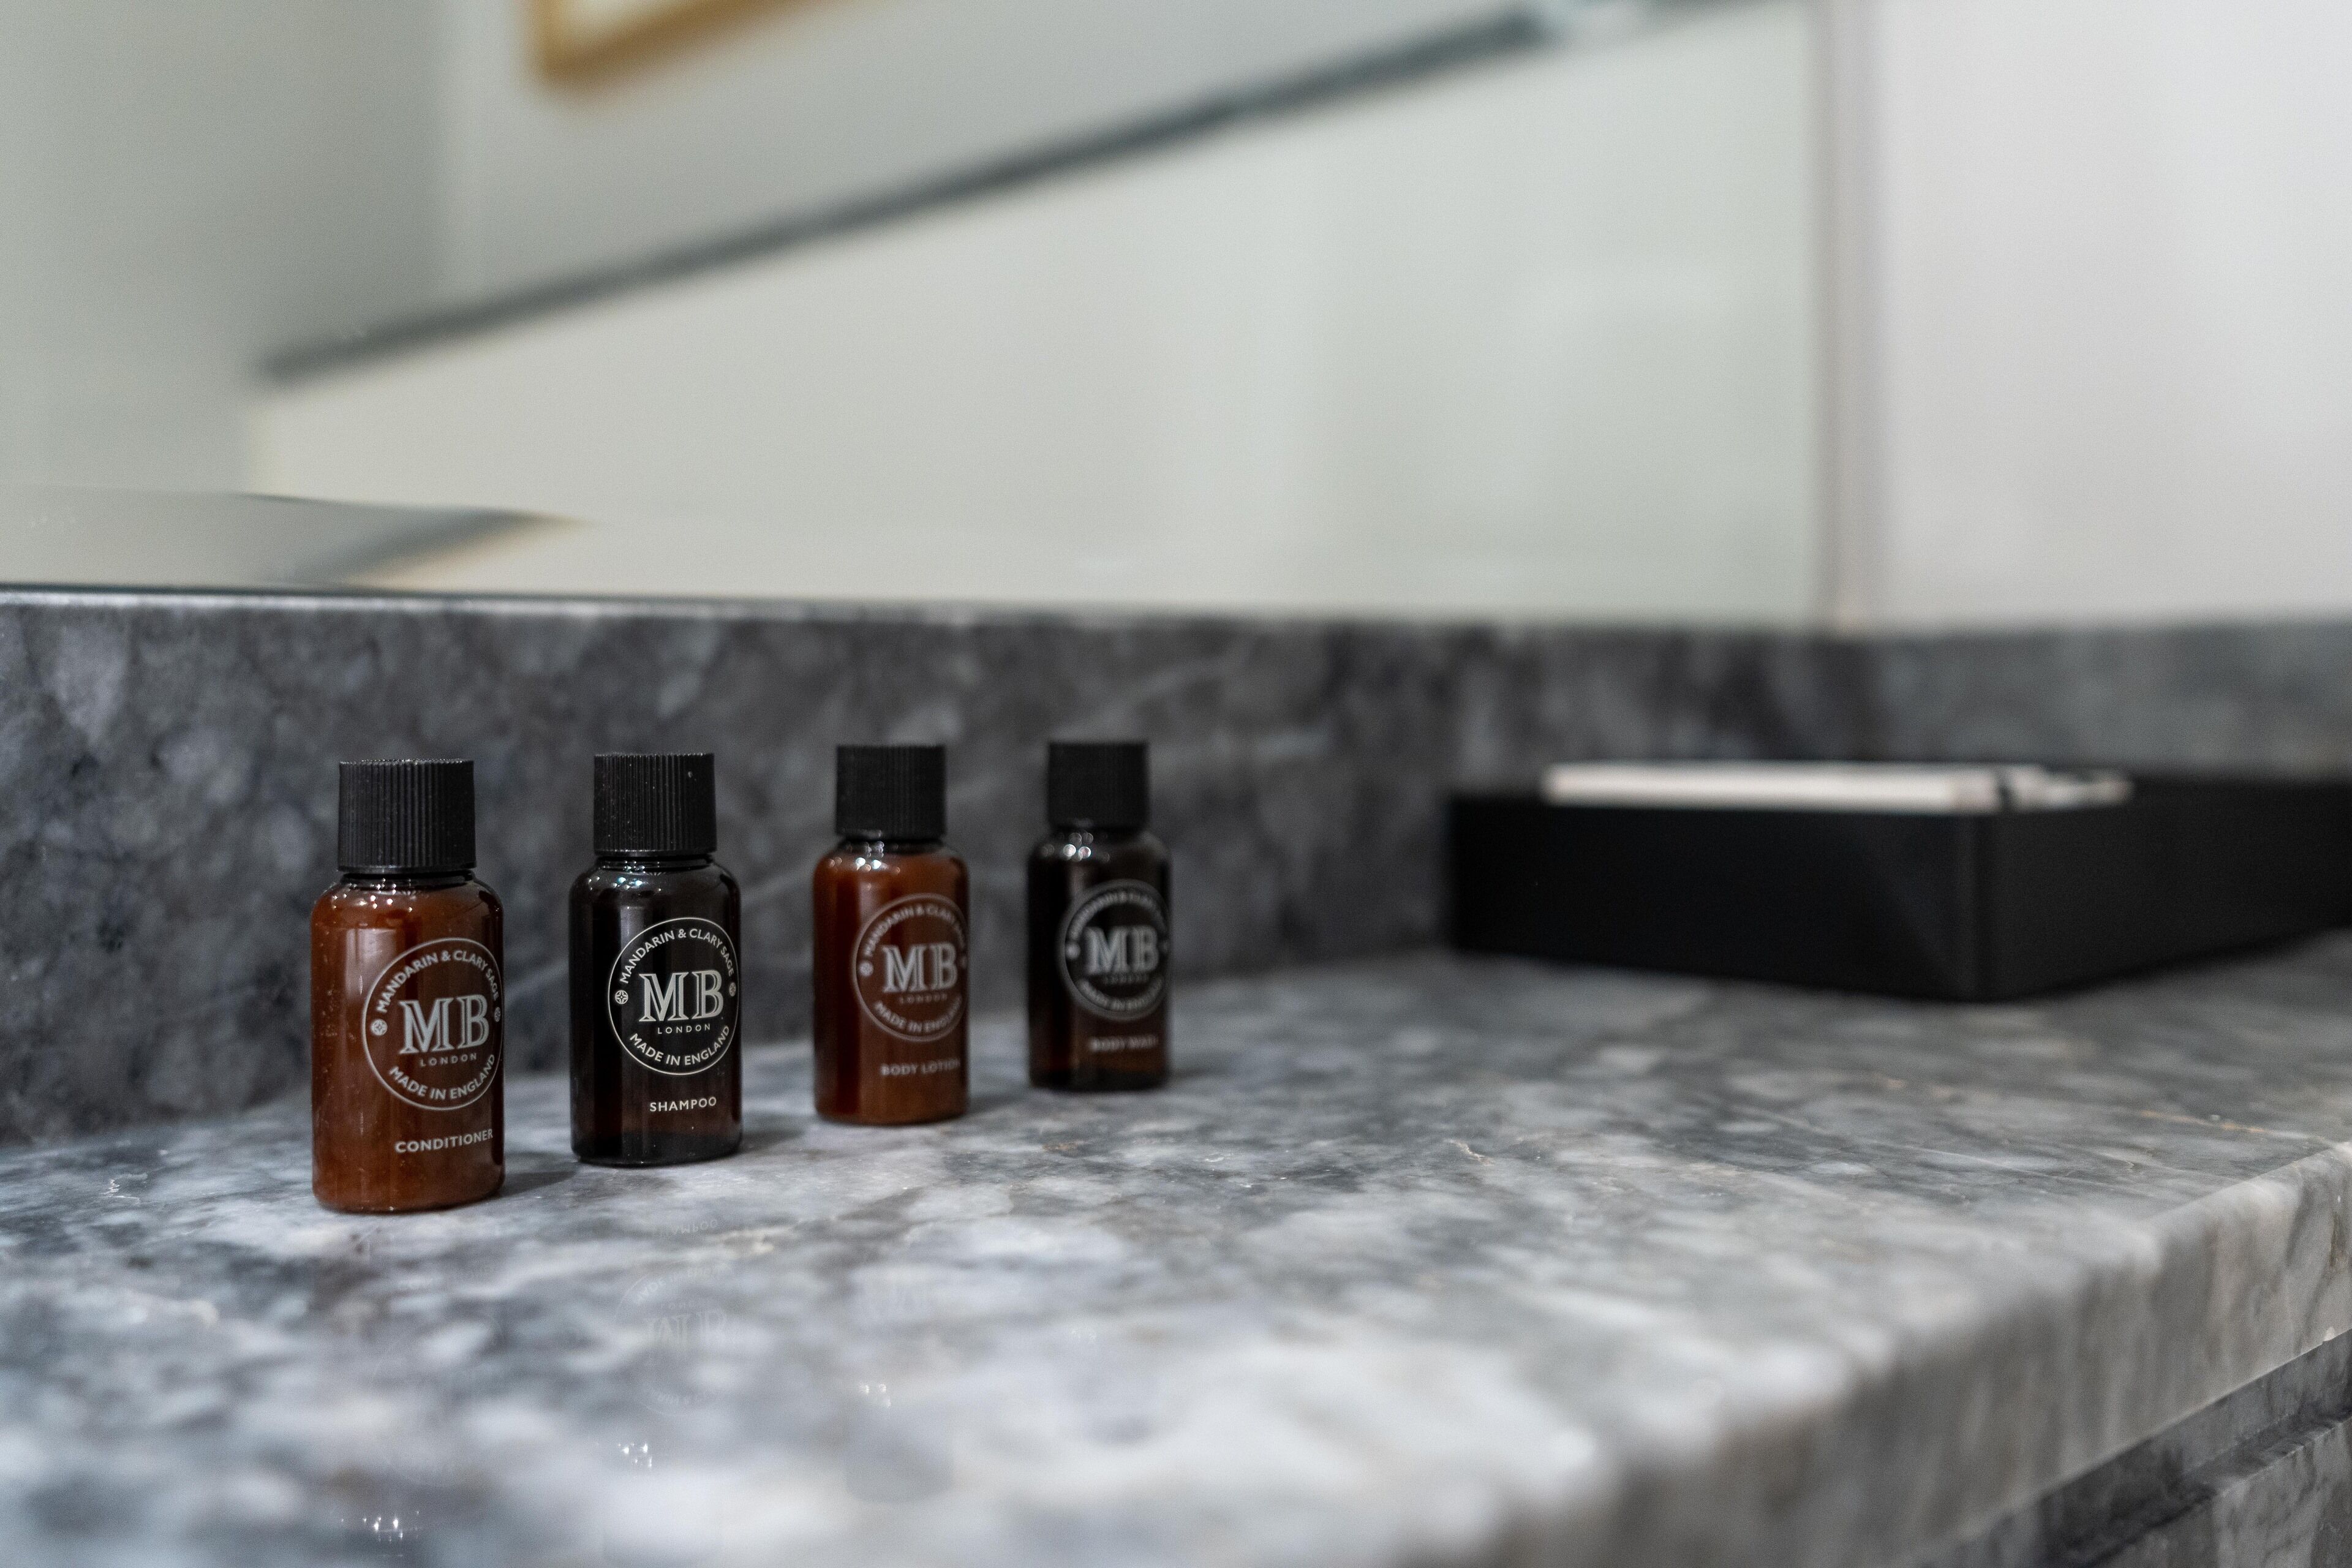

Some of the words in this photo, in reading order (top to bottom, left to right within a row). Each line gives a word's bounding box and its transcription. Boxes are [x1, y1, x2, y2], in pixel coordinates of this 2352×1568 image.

[620, 930, 675, 984] MANDARIN
[678, 929, 687, 938] &
[689, 929, 723, 948] CLARY
[720, 946, 734, 977] SAGE
[882, 941, 958, 993] MB
[1084, 924, 1159, 975] MB
[377, 952, 439, 1012] MANDARIN
[440, 950, 452, 962] &
[453, 950, 488, 971] CLARY
[486, 968, 499, 1001] SAGE
[639, 969, 724, 1022] MB
[398, 993, 490, 1054] MB
[630, 1033, 663, 1062] MADE
[666, 1054, 680, 1066] IN
[684, 1025, 729, 1065] ENGLAND
[658, 1023, 710, 1035] LONDON
[389, 1066, 428, 1097] MADE
[430, 1088, 447, 1100] IN
[450, 1054, 495, 1100] ENGLAND
[420, 1052, 477, 1067] LONDON
[880, 1063, 918, 1076] BODY
[650, 1096, 717, 1112] SHAMPOO
[394, 1129, 494, 1153] CONDITIONER
